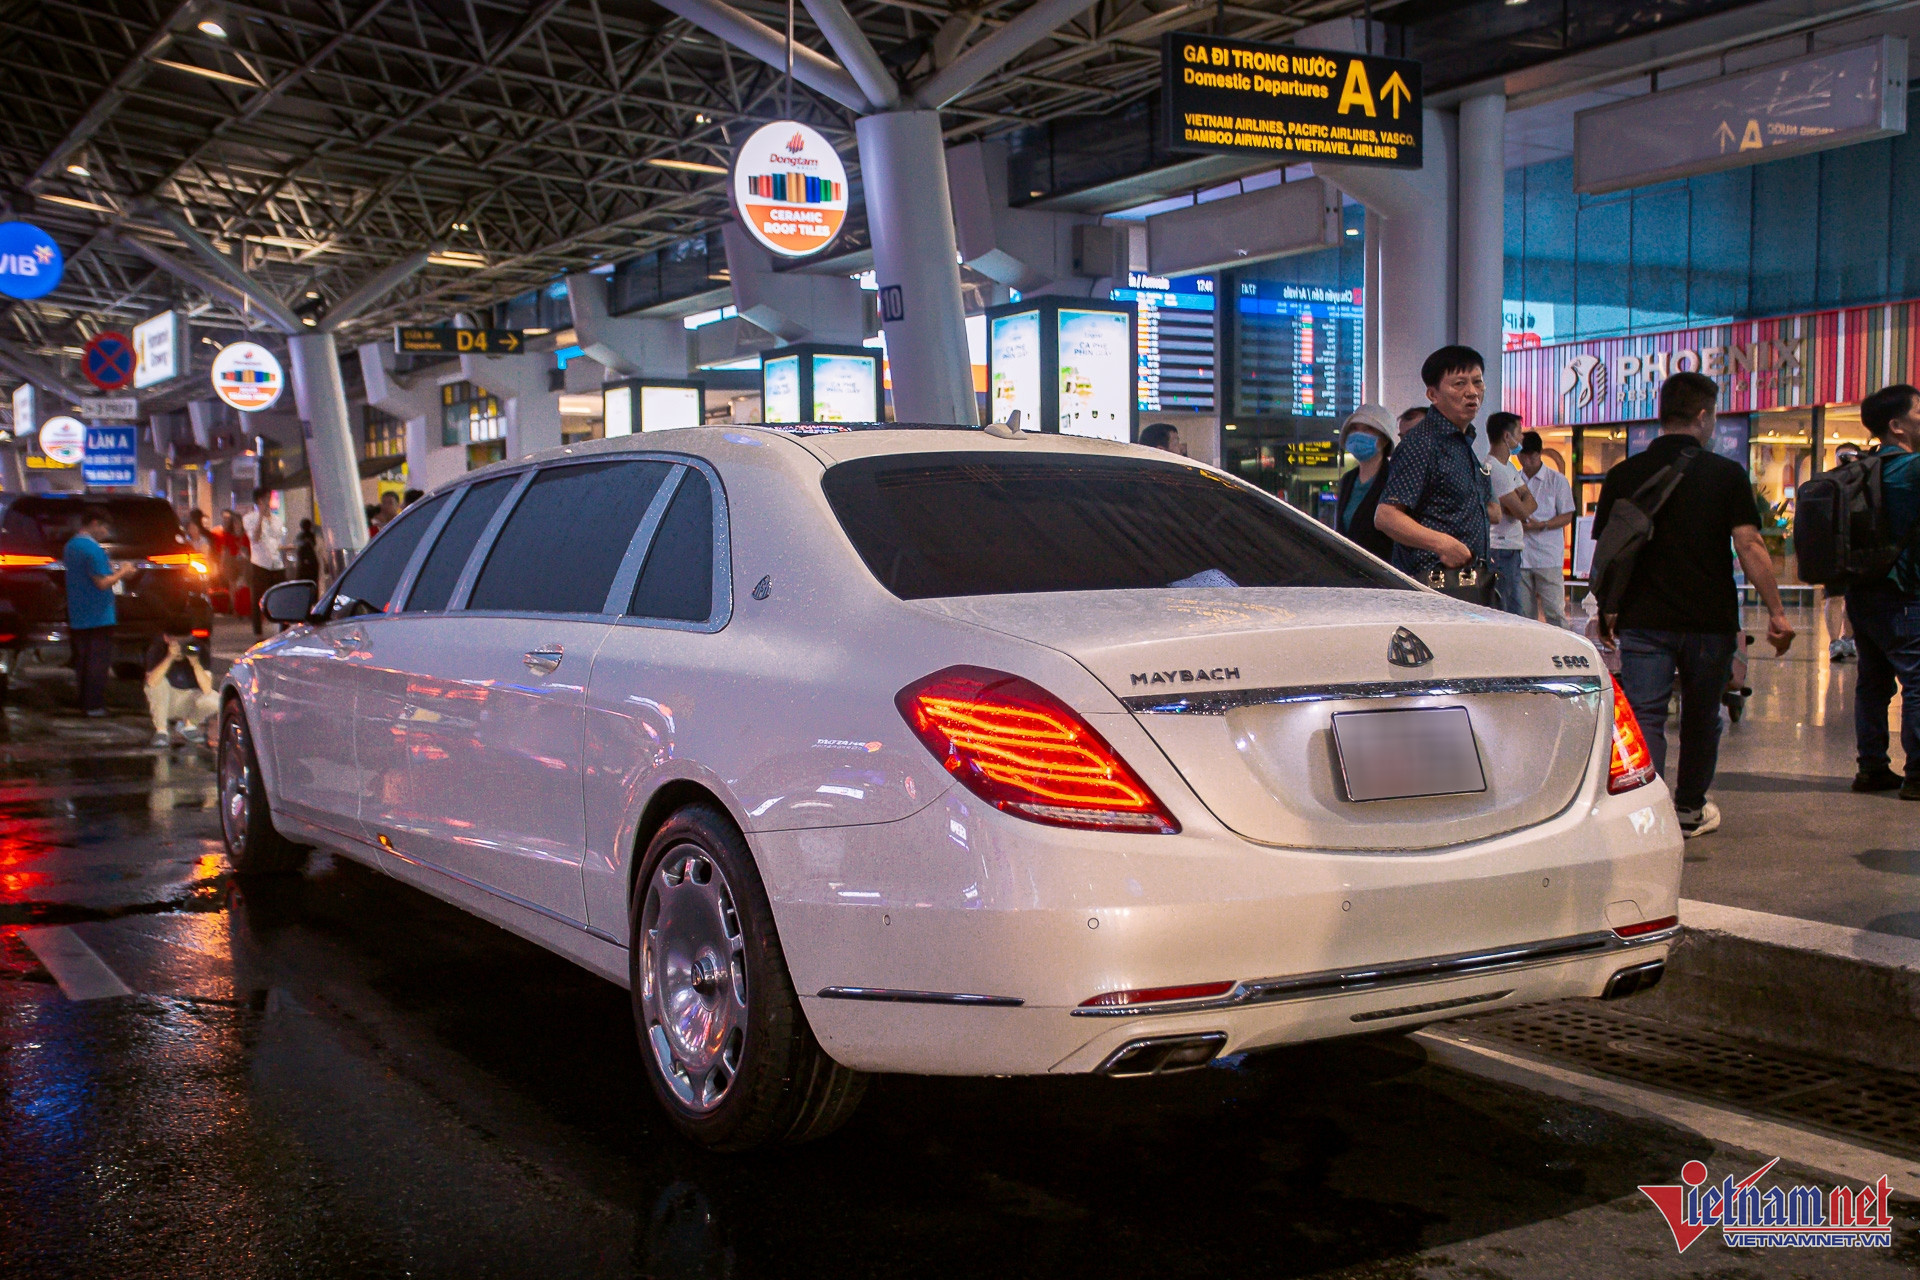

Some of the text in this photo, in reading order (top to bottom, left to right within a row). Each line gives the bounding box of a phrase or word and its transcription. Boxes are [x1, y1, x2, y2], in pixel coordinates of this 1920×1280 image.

[1183, 44, 1338, 78] GA ĐI TRONG NƯỚC
[1184, 68, 1329, 99] Domestic Departures
[1337, 59, 1377, 117] A
[1185, 113, 1416, 147] VIETNAM AIRLINES, PACIFIC AIRLINES, VASCO,
[1185, 128, 1398, 160] BAMBOO AIRWAYS & VIETRAVEL AIRLINES
[769, 153, 819, 167] Dongtam
[763, 221, 831, 237] ROOF TILES
[769, 208, 823, 223] CERAMIC
[882, 287, 902, 319] 10
[456, 330, 488, 351] D4
[1616, 338, 1803, 386] PHOENIX
[1129, 667, 1240, 686] MAYBACH
[1551, 655, 1562, 668] S
